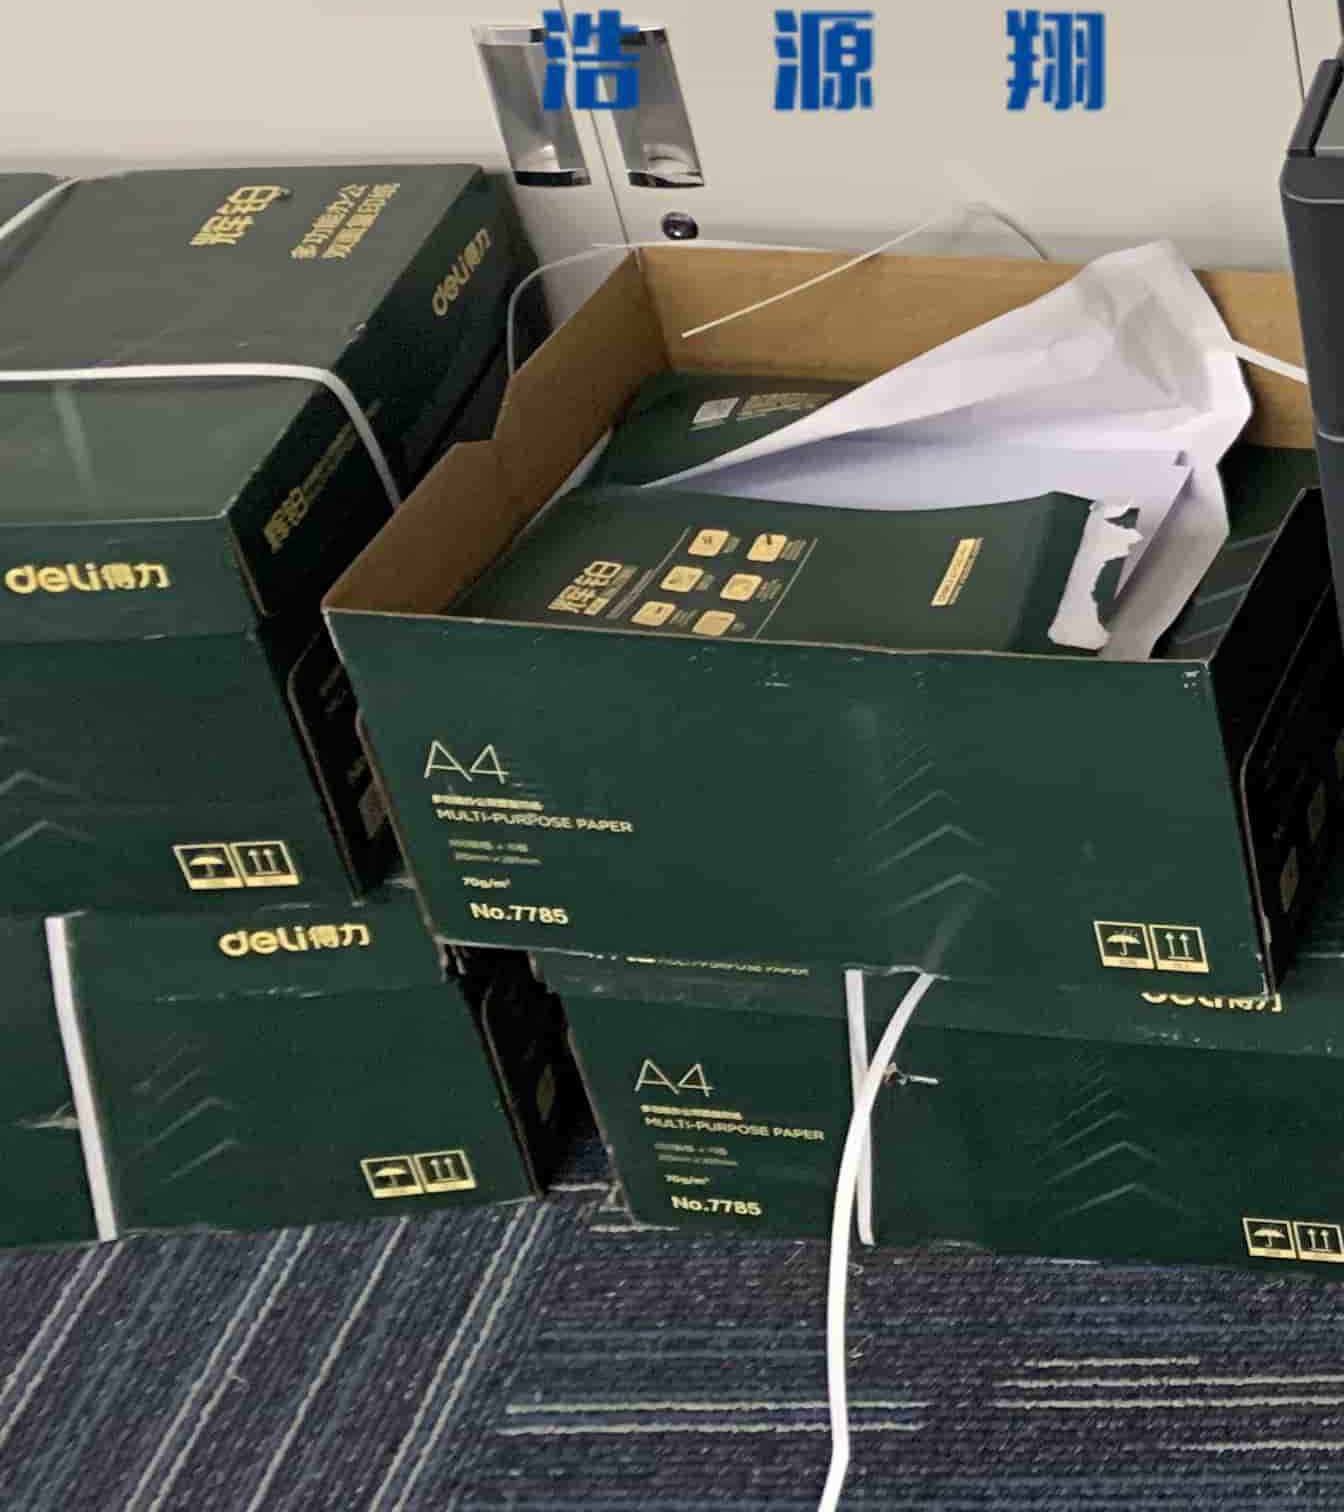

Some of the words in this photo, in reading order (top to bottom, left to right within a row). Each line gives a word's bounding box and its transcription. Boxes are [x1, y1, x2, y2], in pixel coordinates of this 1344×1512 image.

[423, 739, 510, 784] A4
[435, 808, 574, 830] MULTI-PURPOSE
[576, 817, 634, 834] PAPER
[469, 901, 570, 925] No.7785
[634, 1059, 715, 1097] A4
[644, 1115, 770, 1137] MULTI-PURPOSE
[772, 1127, 825, 1141] PAPER
[671, 1195, 763, 1217] No.7785
